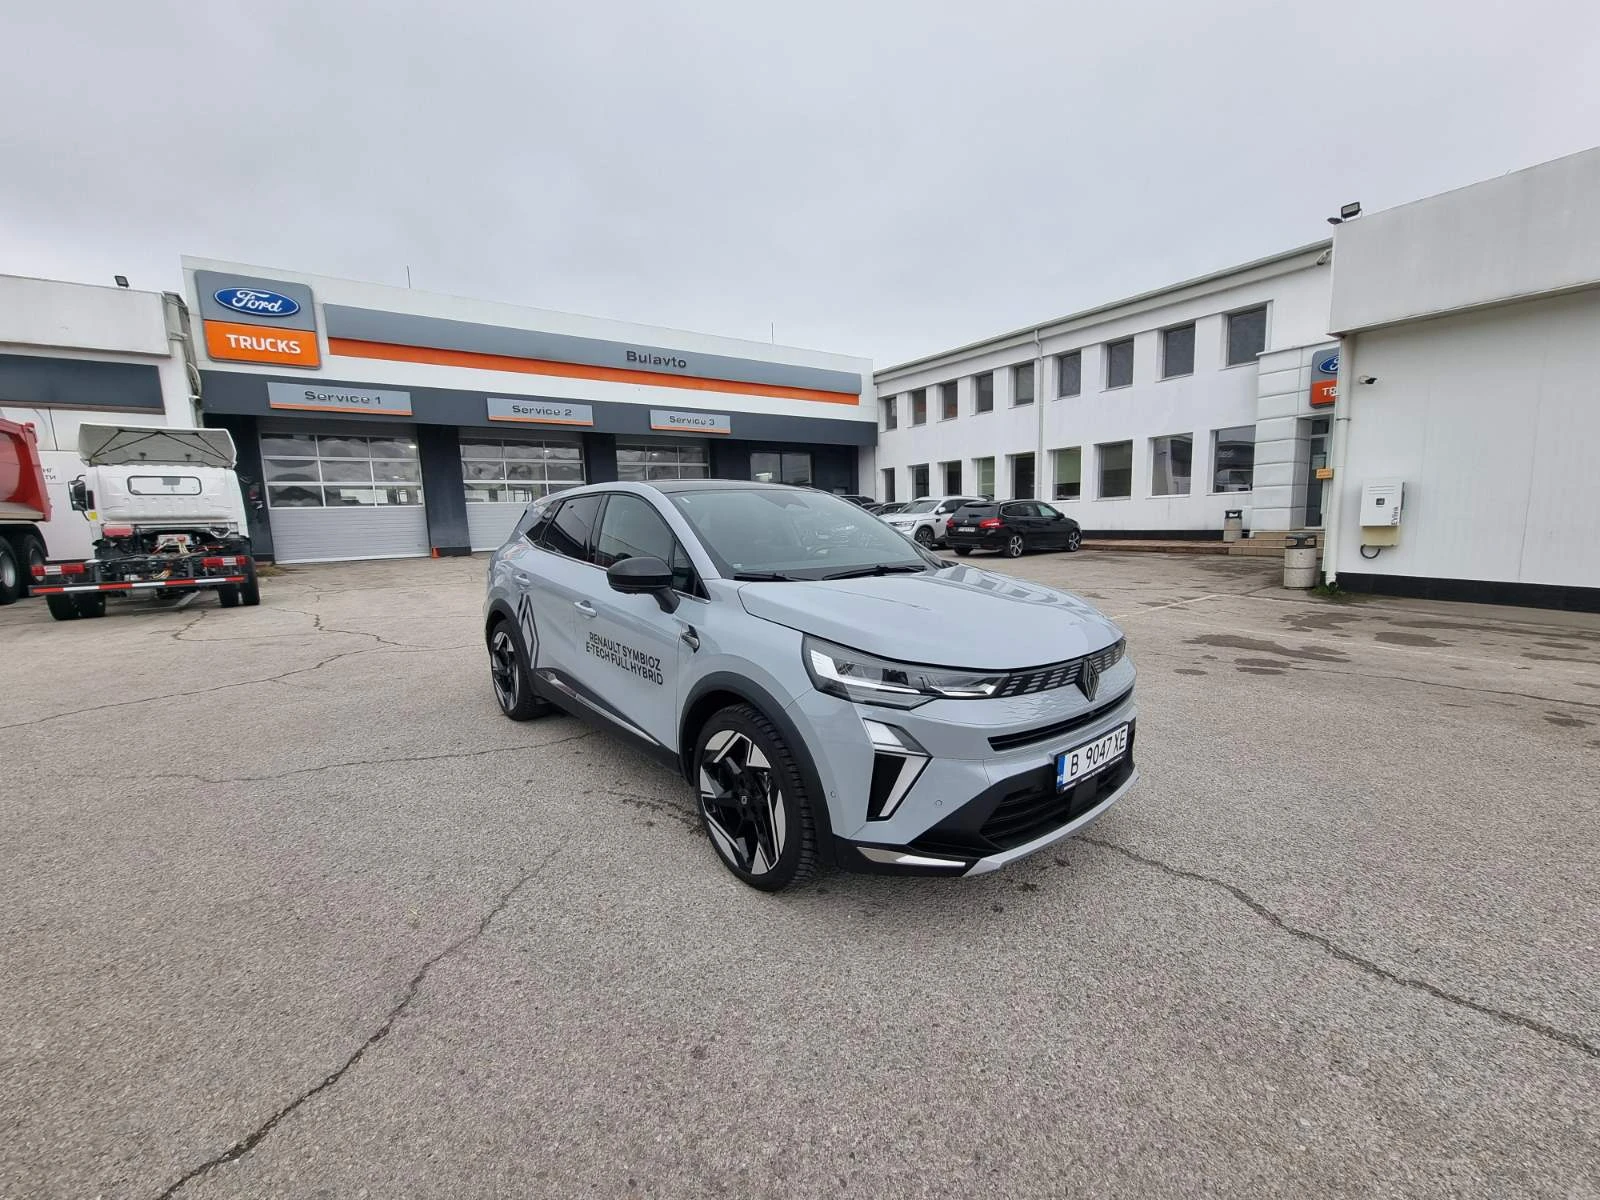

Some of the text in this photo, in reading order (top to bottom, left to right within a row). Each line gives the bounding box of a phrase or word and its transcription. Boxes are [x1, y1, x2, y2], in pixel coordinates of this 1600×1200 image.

[232, 290, 282, 312] Ford
[225, 333, 301, 354] TRUCKS
[626, 350, 687, 369] Bulavto
[304, 390, 381, 405] Service 1
[512, 405, 572, 416] Service 2
[669, 415, 715, 426] Service 3
[589, 632, 661, 671] RENAULT SYMBIOZ
[586, 641, 664, 685] E-TECH FULL HYBRID
[1070, 753, 1079, 777] B
[1086, 736, 1113, 769] 9047
[1113, 729, 1127, 753] XE
